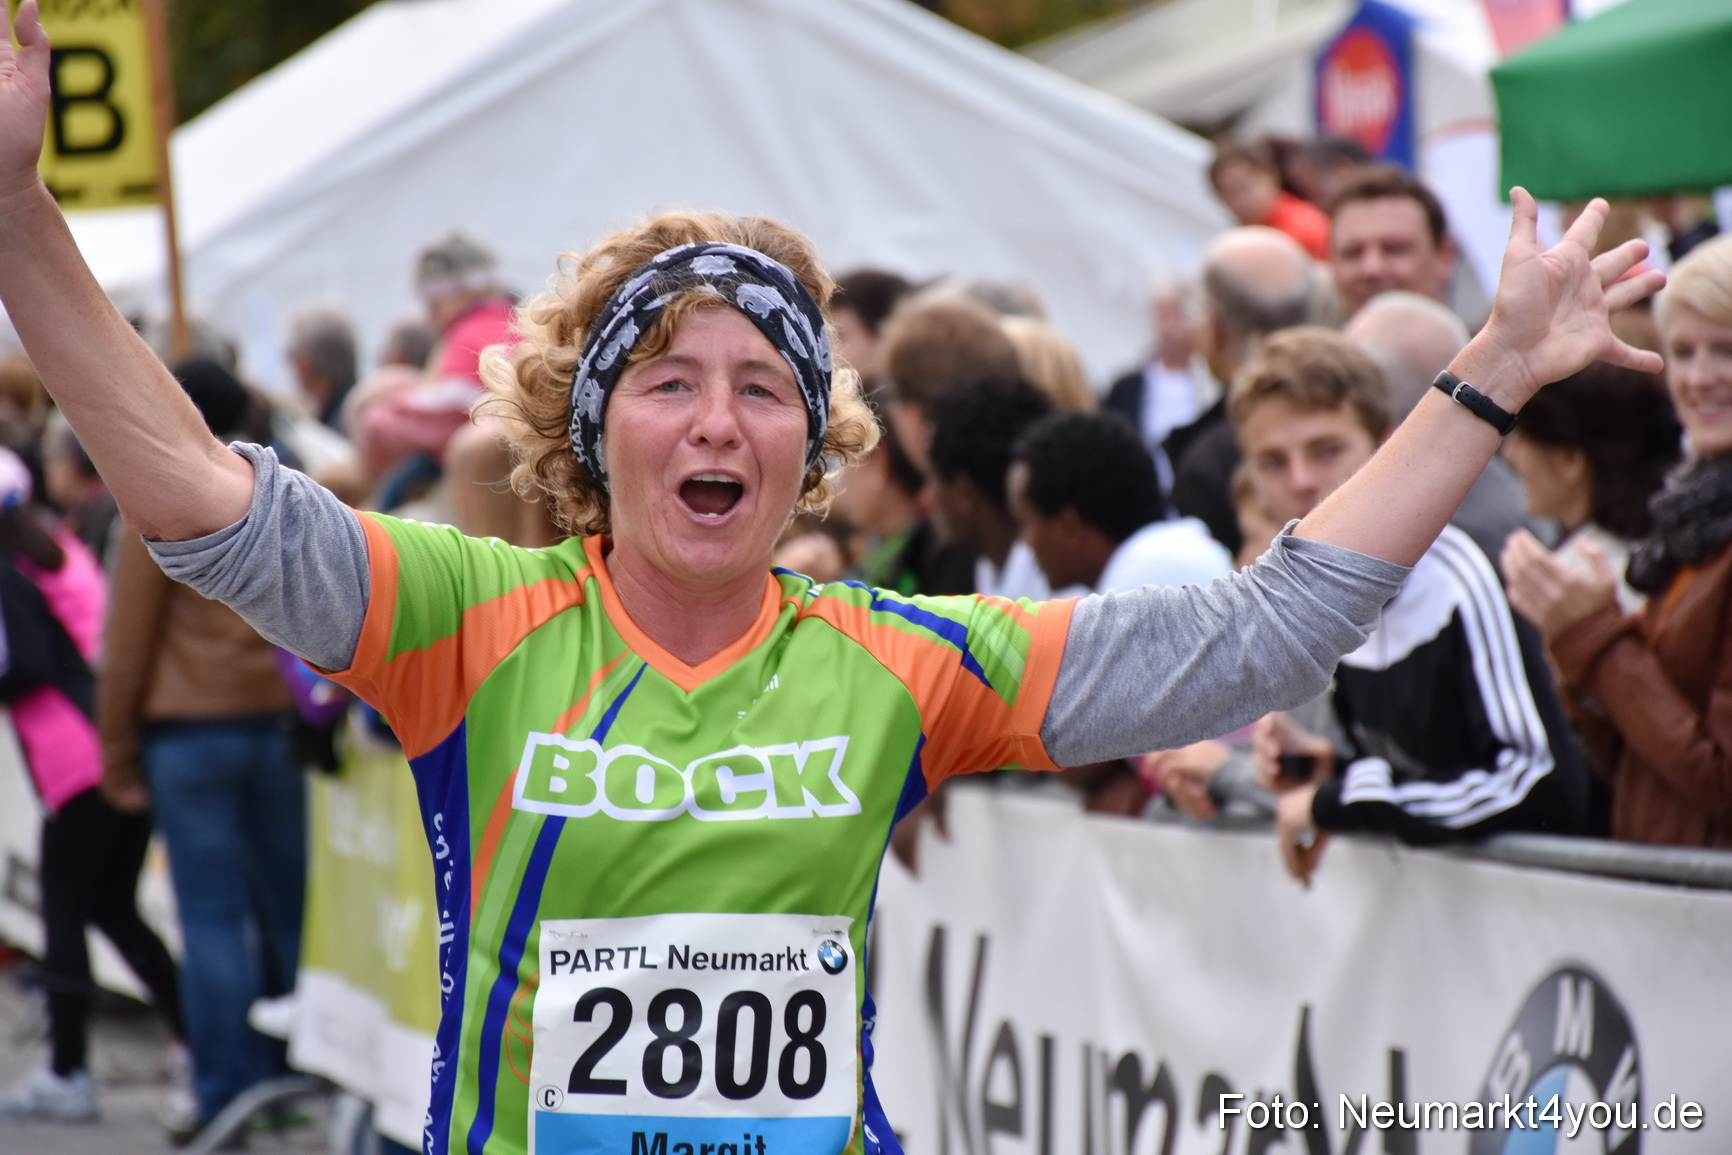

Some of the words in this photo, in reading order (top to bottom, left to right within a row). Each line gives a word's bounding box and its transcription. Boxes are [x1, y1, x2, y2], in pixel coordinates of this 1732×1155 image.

[49, 45, 126, 157] B
[511, 731, 862, 821] BOCK
[549, 945, 658, 976] PARTL
[667, 944, 810, 972] Neumarkt
[566, 986, 828, 1101] 2808
